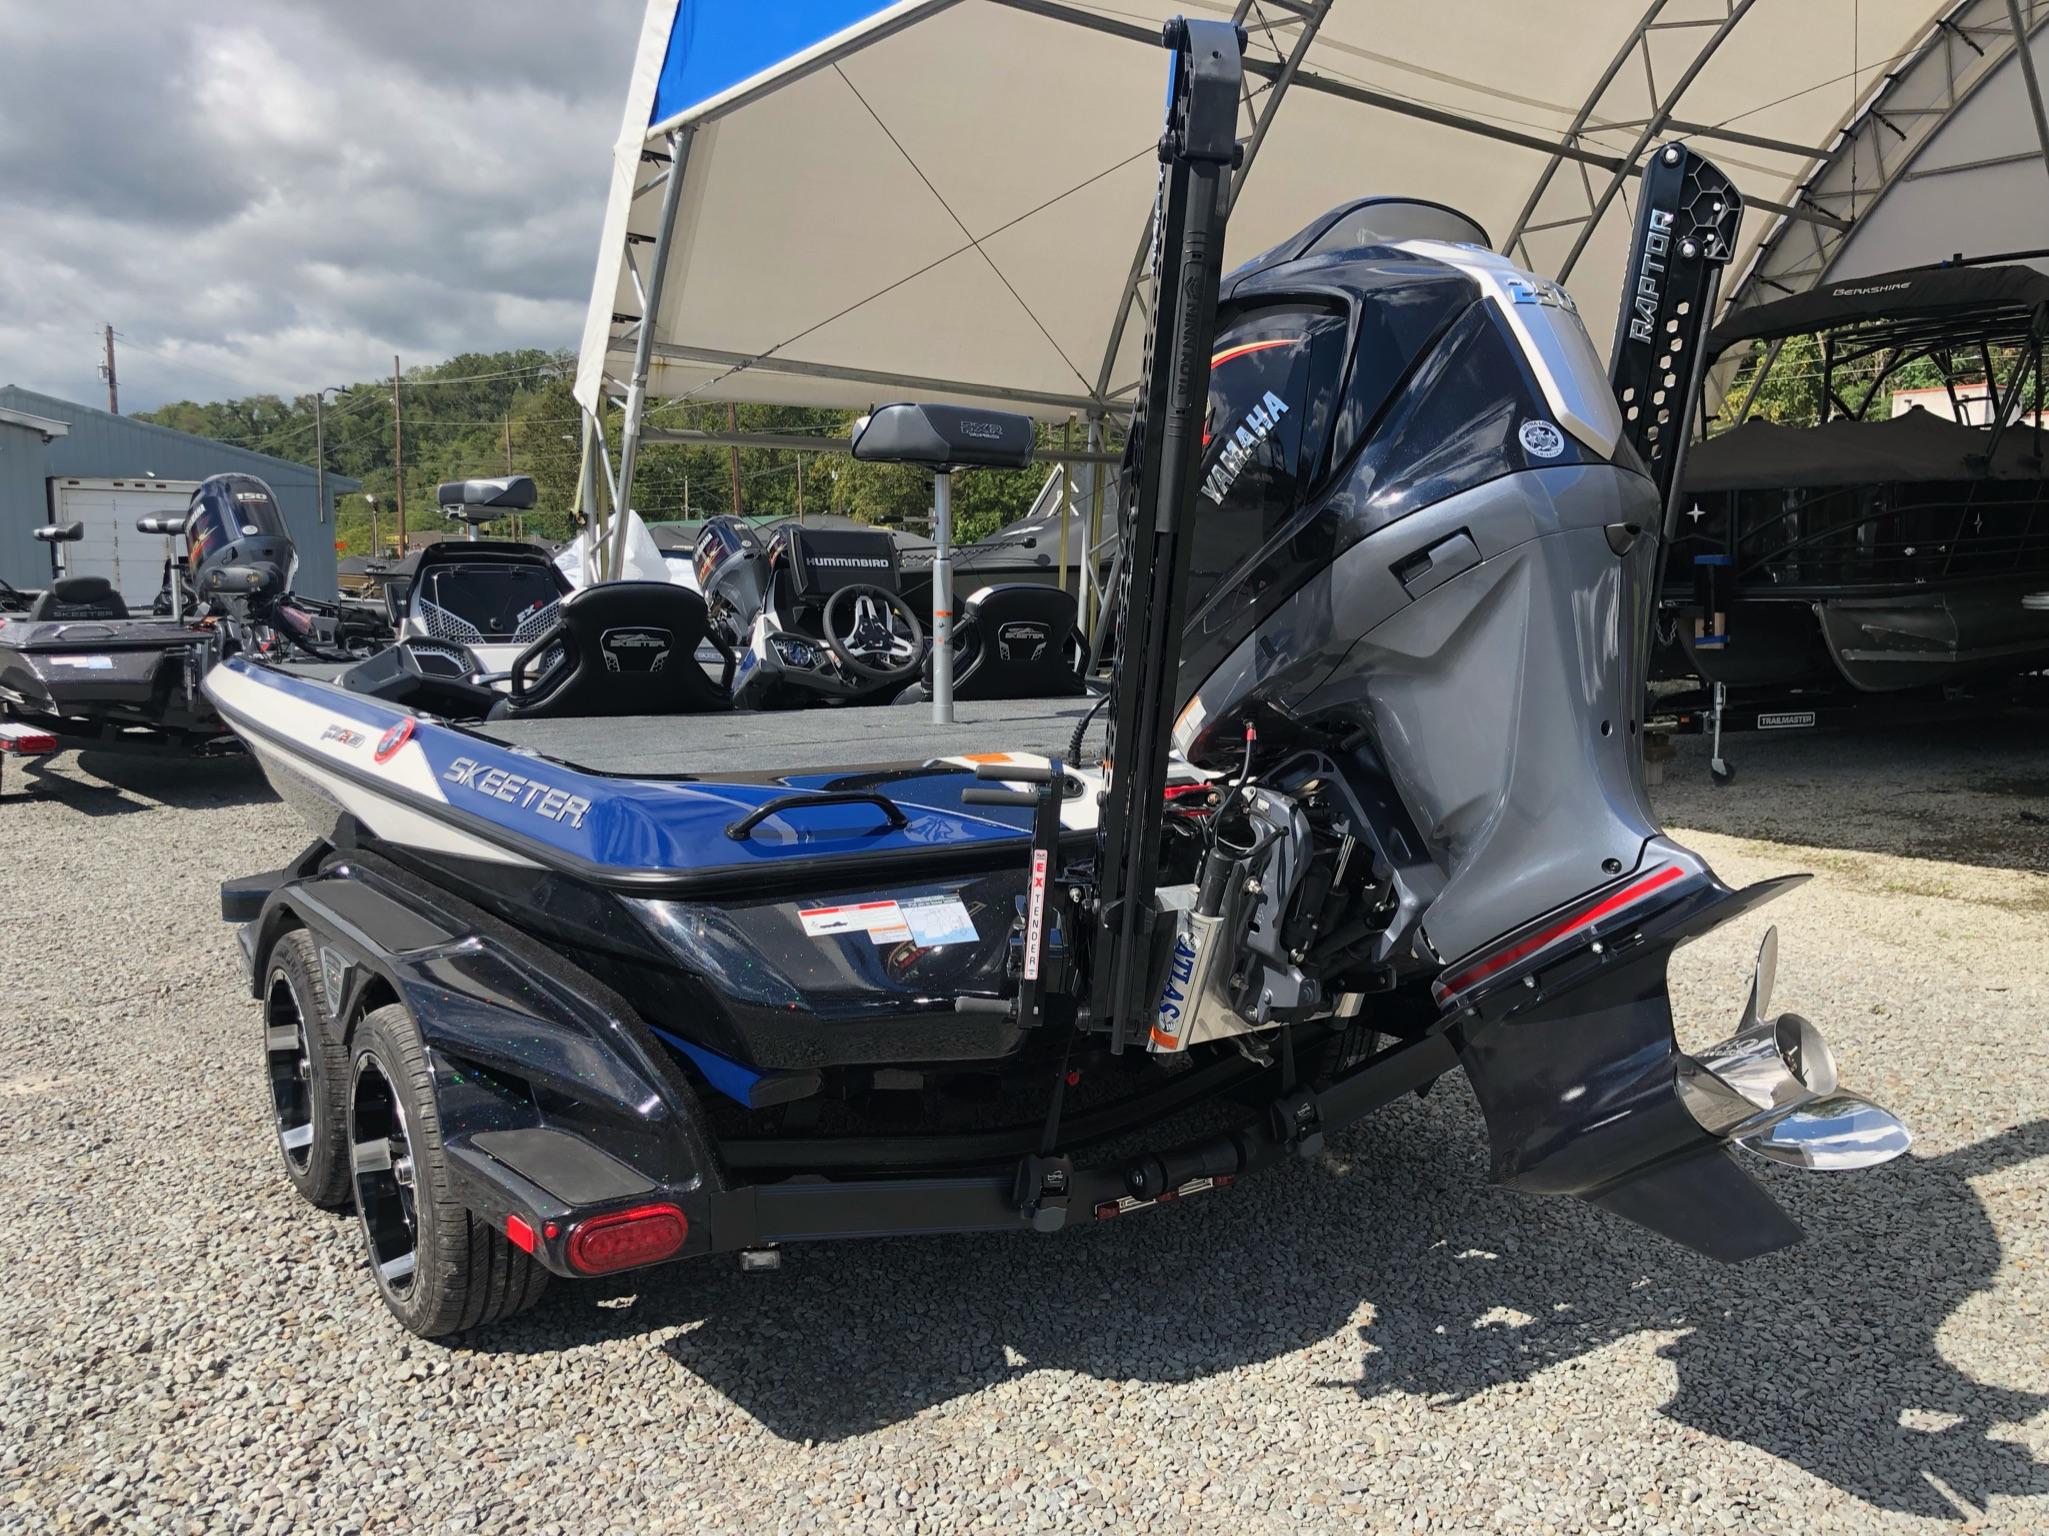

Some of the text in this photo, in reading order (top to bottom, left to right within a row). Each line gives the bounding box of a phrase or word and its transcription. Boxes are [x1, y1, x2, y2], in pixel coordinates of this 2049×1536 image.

[1629, 208, 1674, 345] RAPTOR
[1832, 281, 1912, 297] BERKSHIRE
[1200, 390, 1290, 506] YAMAHA
[236, 492, 268, 500] 150
[806, 557, 889, 568] HUMMINBIRD
[1761, 715, 1812, 725] TRAILMASTER
[443, 756, 592, 830] SKEETER
[1029, 862, 1045, 966] EXTENDER
[1160, 937, 1197, 1018] ATLAS
